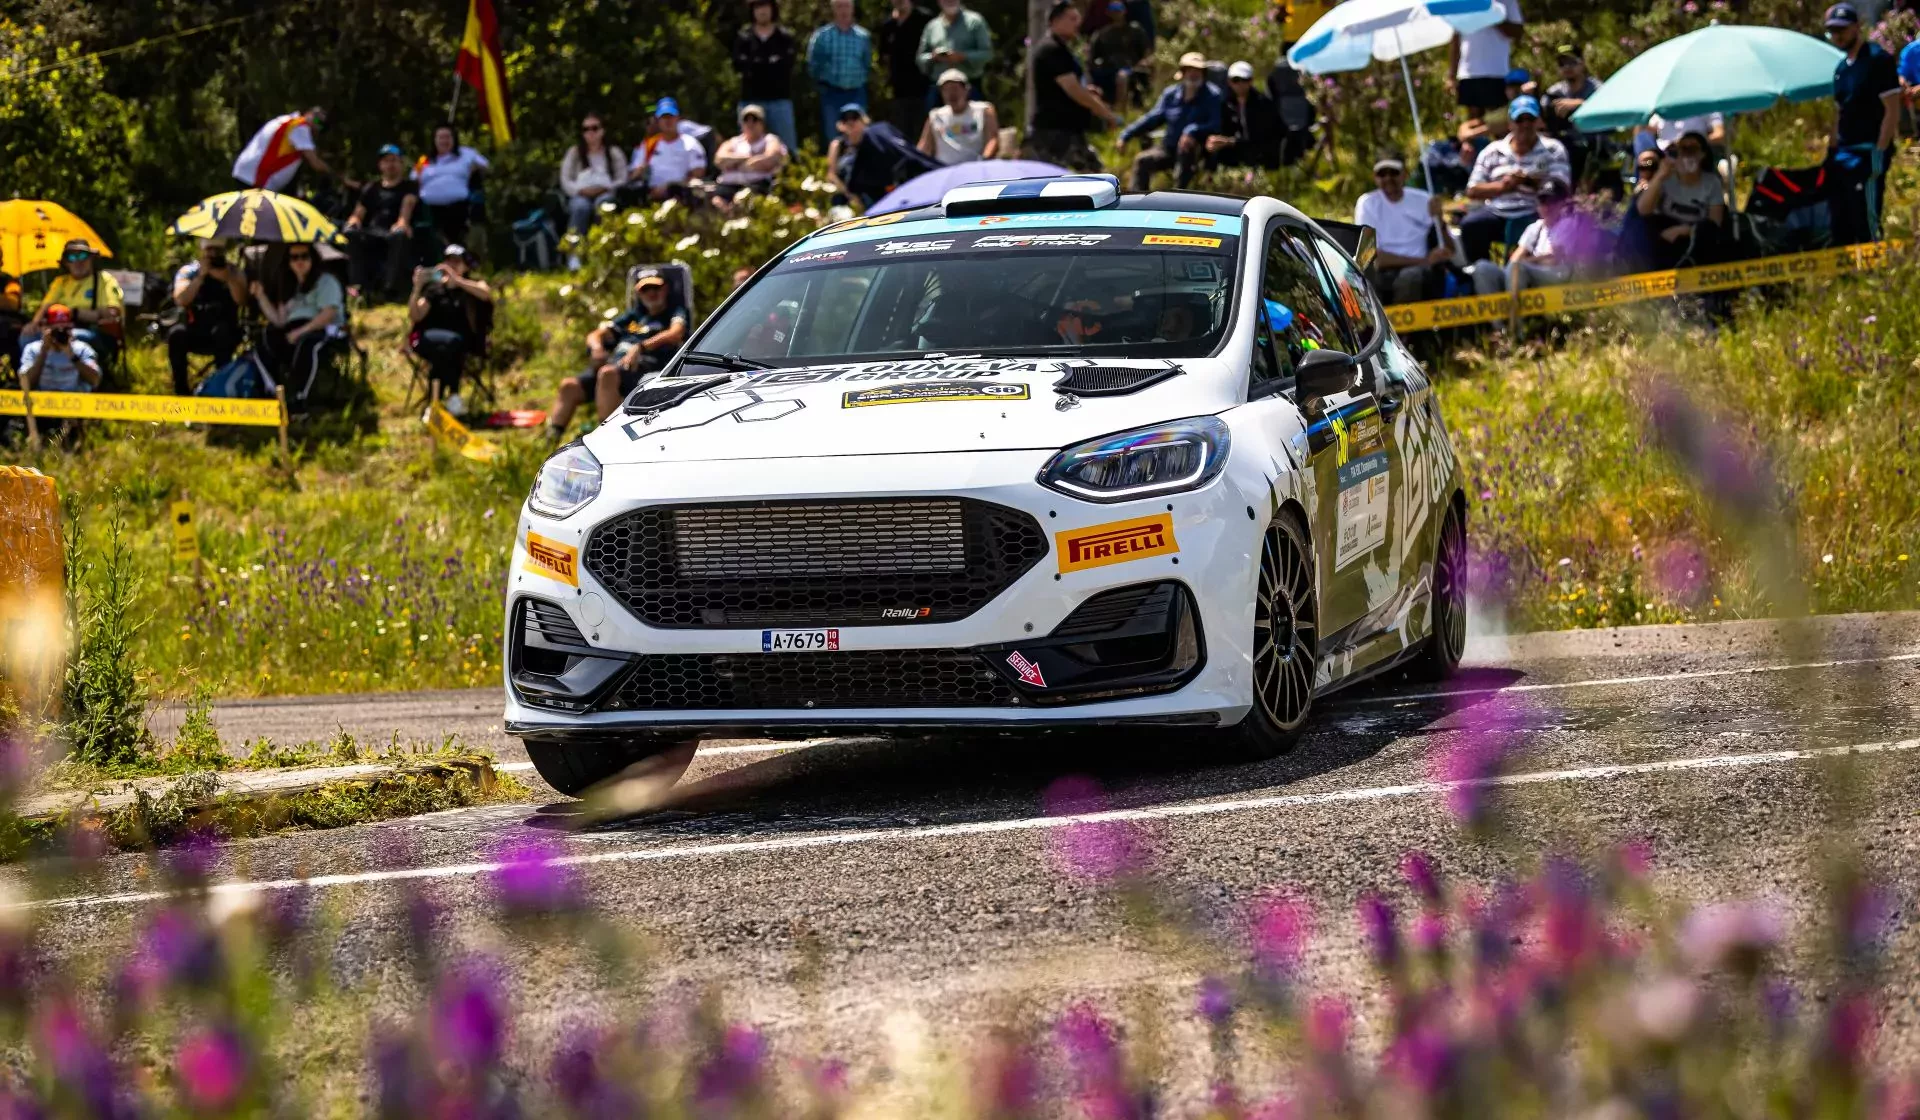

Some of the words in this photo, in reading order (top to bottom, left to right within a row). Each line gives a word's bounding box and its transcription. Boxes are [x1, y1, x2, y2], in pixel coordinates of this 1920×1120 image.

[1433, 302, 1473, 322] ZONA
[1478, 292, 1546, 316] PUBICO
[862, 362, 1038, 372] OUNEVA
[845, 370, 1001, 382] GROUP
[987, 386, 1017, 394] 36
[95, 397, 126, 411] ZONA
[195, 402, 226, 417] ZONA
[1067, 523, 1166, 564] PIRELLI
[530, 541, 572, 577] PIRELLI
[881, 607, 931, 620] Rally3
[828, 631, 837, 640] 10
[828, 641, 837, 650] 26
[1010, 654, 1038, 681] SERVICE
